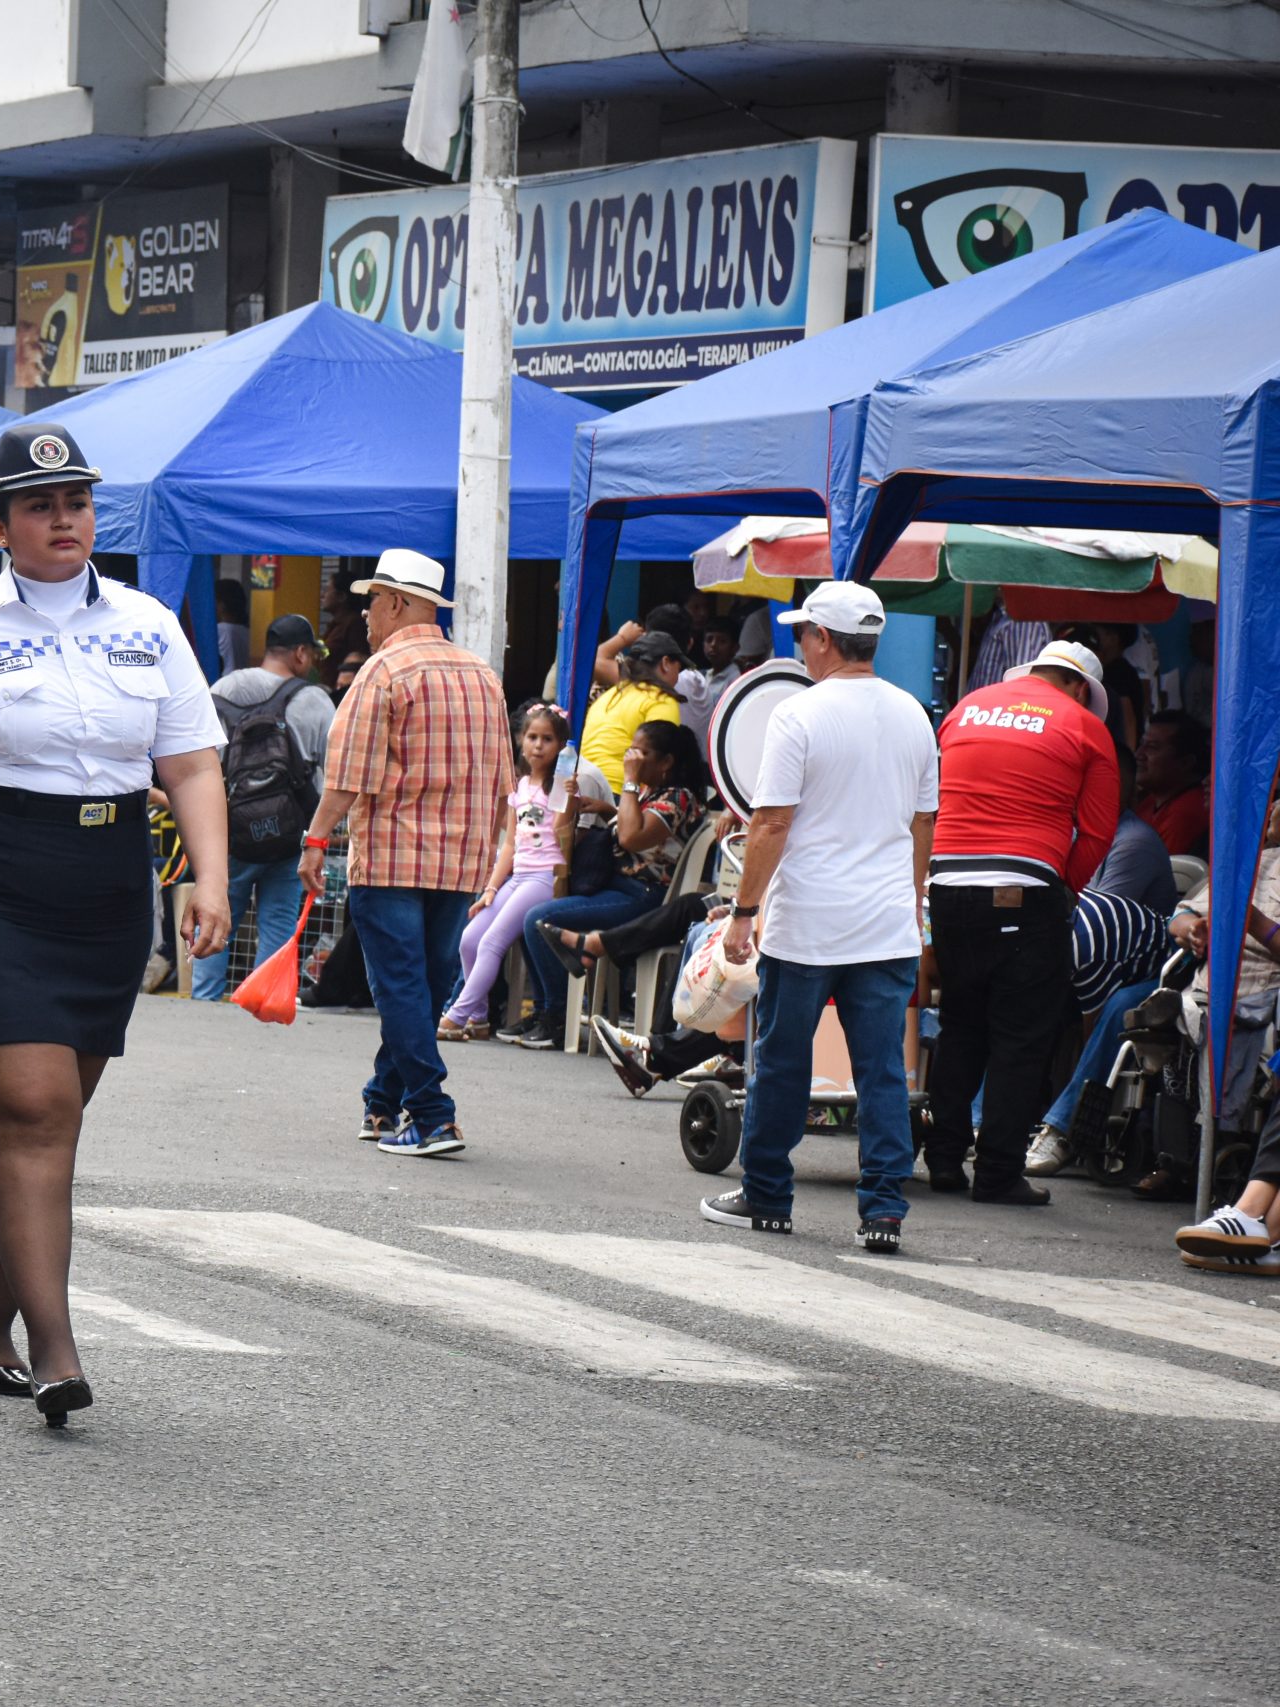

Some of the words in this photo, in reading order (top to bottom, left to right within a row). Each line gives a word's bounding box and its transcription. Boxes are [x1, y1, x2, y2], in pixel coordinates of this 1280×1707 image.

[139, 218, 219, 258] GOLDEN
[562, 174, 798, 322] MEGALENS
[138, 262, 194, 298] BEAR
[84, 352, 118, 374] TALLER
[120, 350, 133, 372] DE
[135, 348, 166, 370] MOTO
[112, 653, 152, 664] TRANSITO
[958, 705, 1046, 734] Polaca
[1007, 702, 1053, 716] Avena
[83, 808, 103, 818] ACT
[250, 816, 281, 841] CAT
